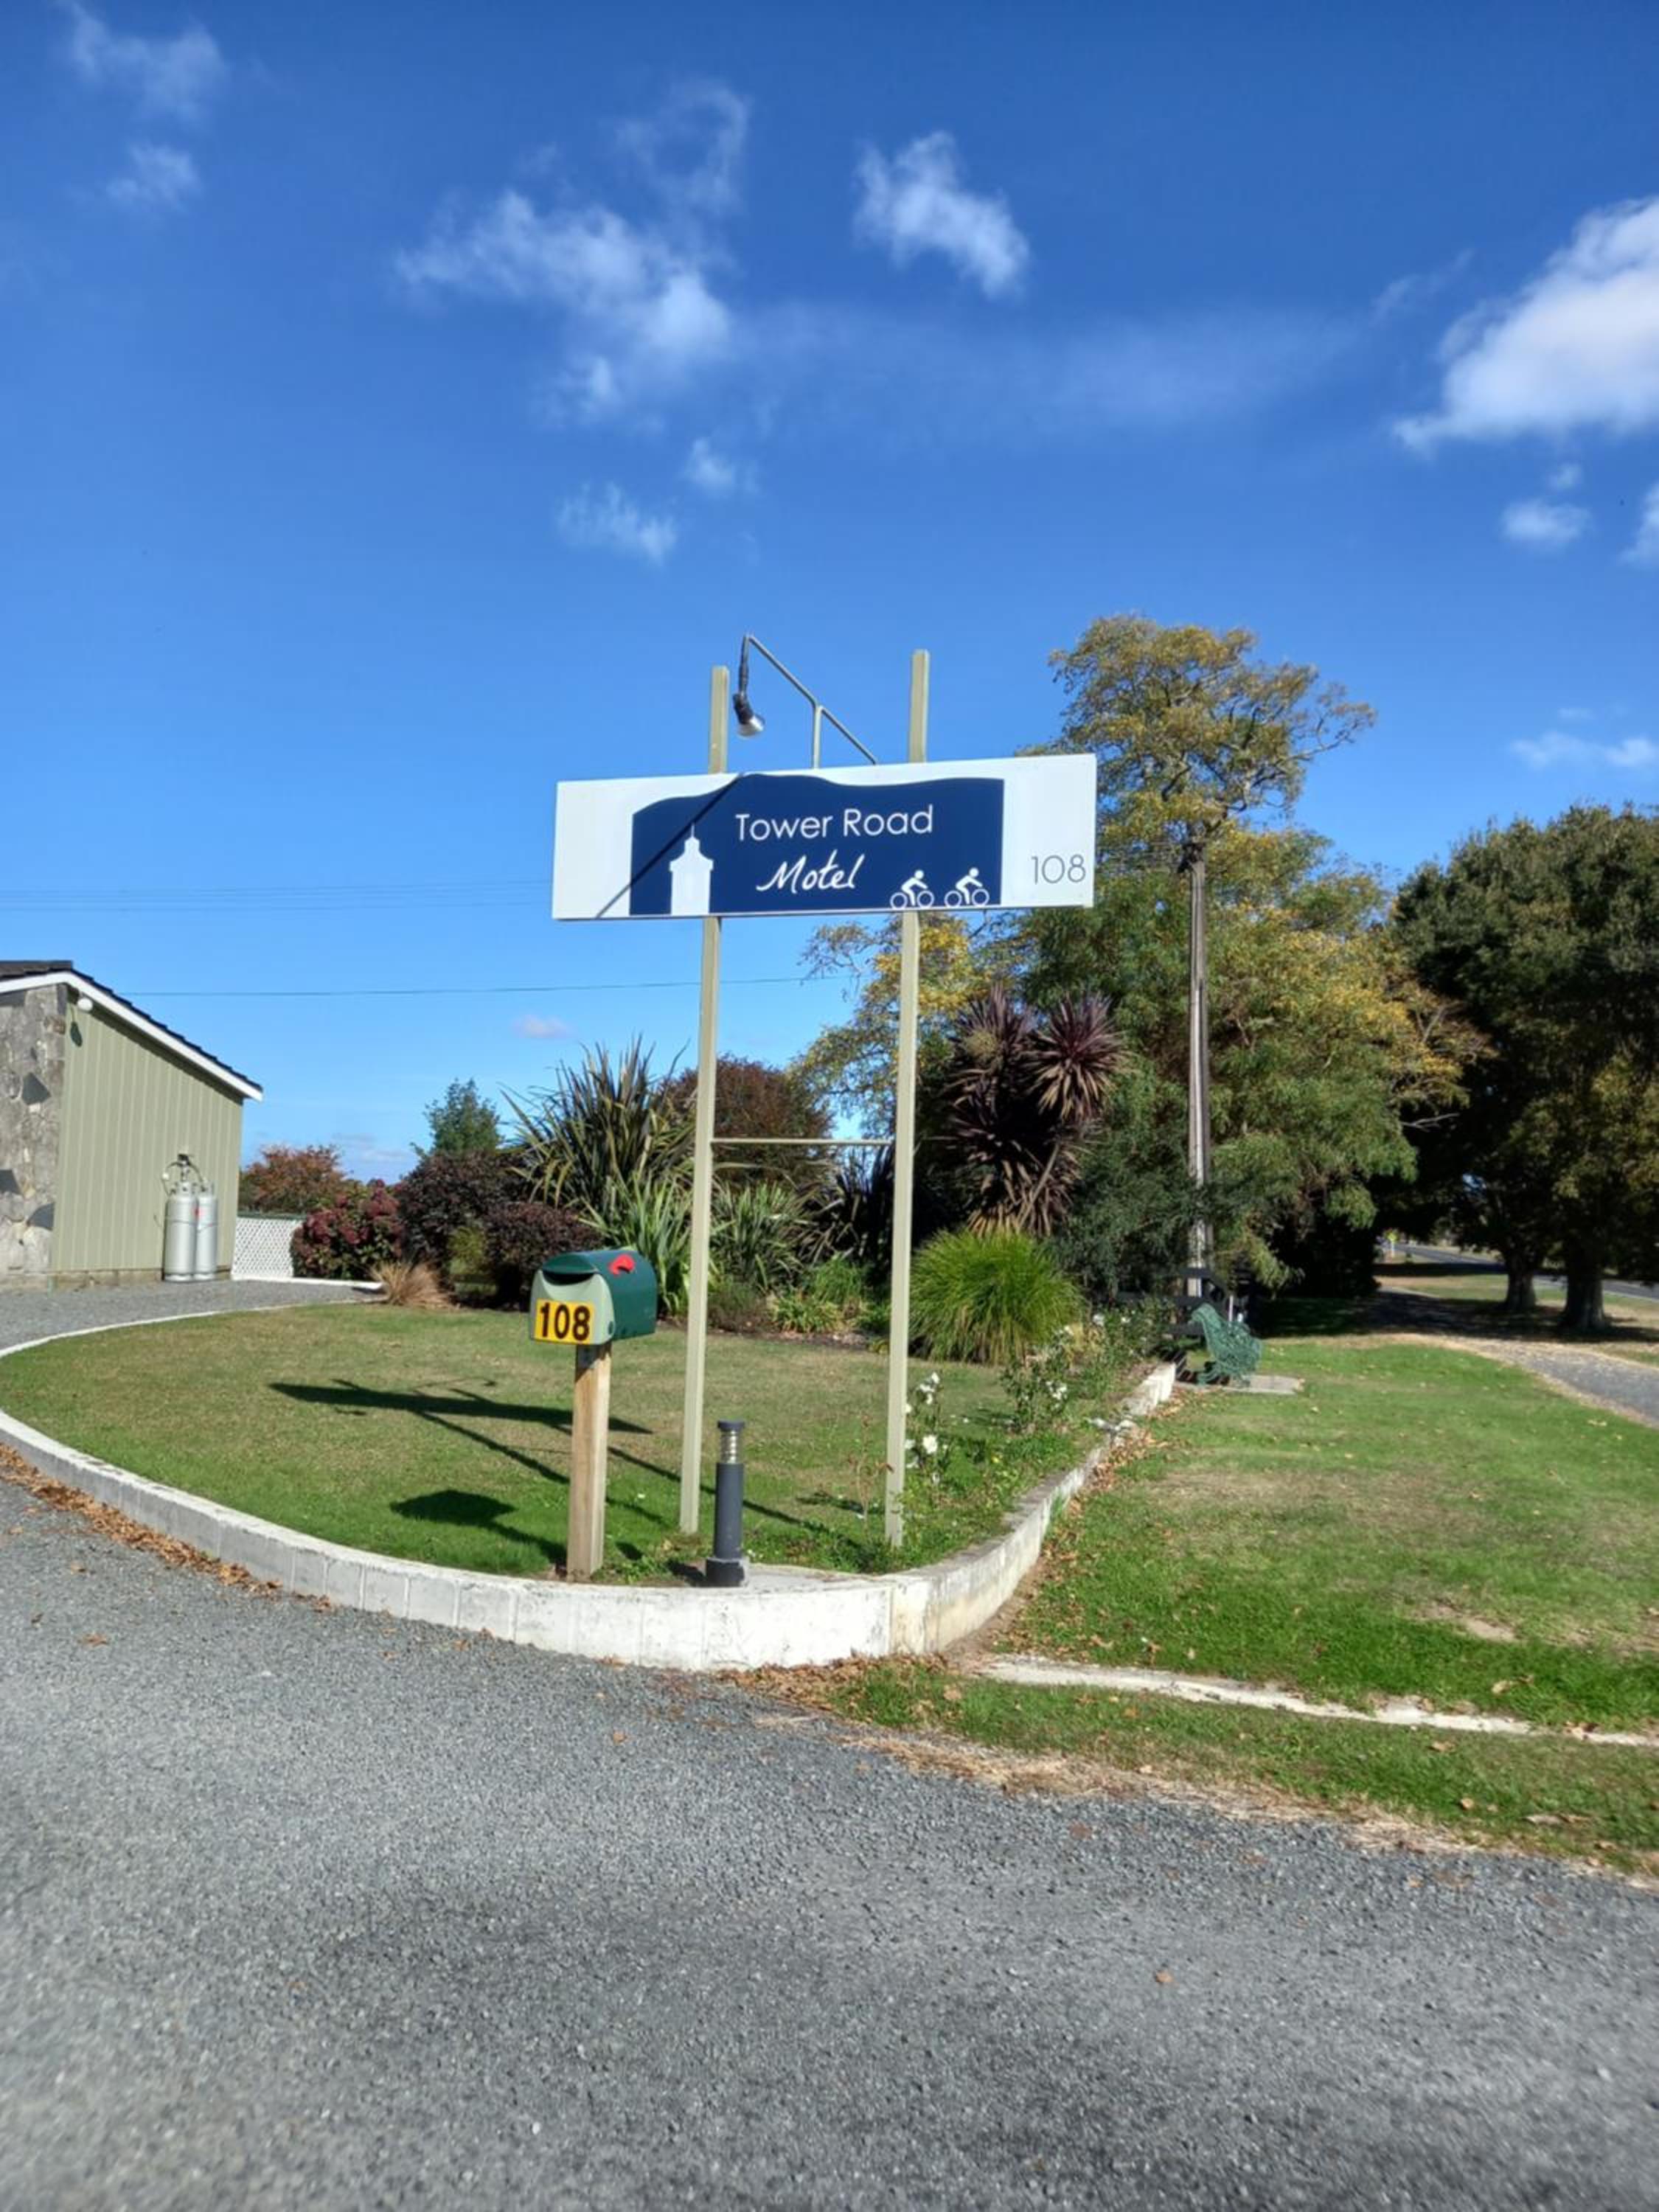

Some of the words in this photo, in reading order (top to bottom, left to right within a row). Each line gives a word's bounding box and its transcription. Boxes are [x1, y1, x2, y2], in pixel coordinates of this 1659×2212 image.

[735, 814, 833, 841] Tower
[843, 802, 933, 837] Road
[756, 849, 865, 894] Motel
[1031, 854, 1086, 885] 108
[540, 1301, 591, 1341] 108
